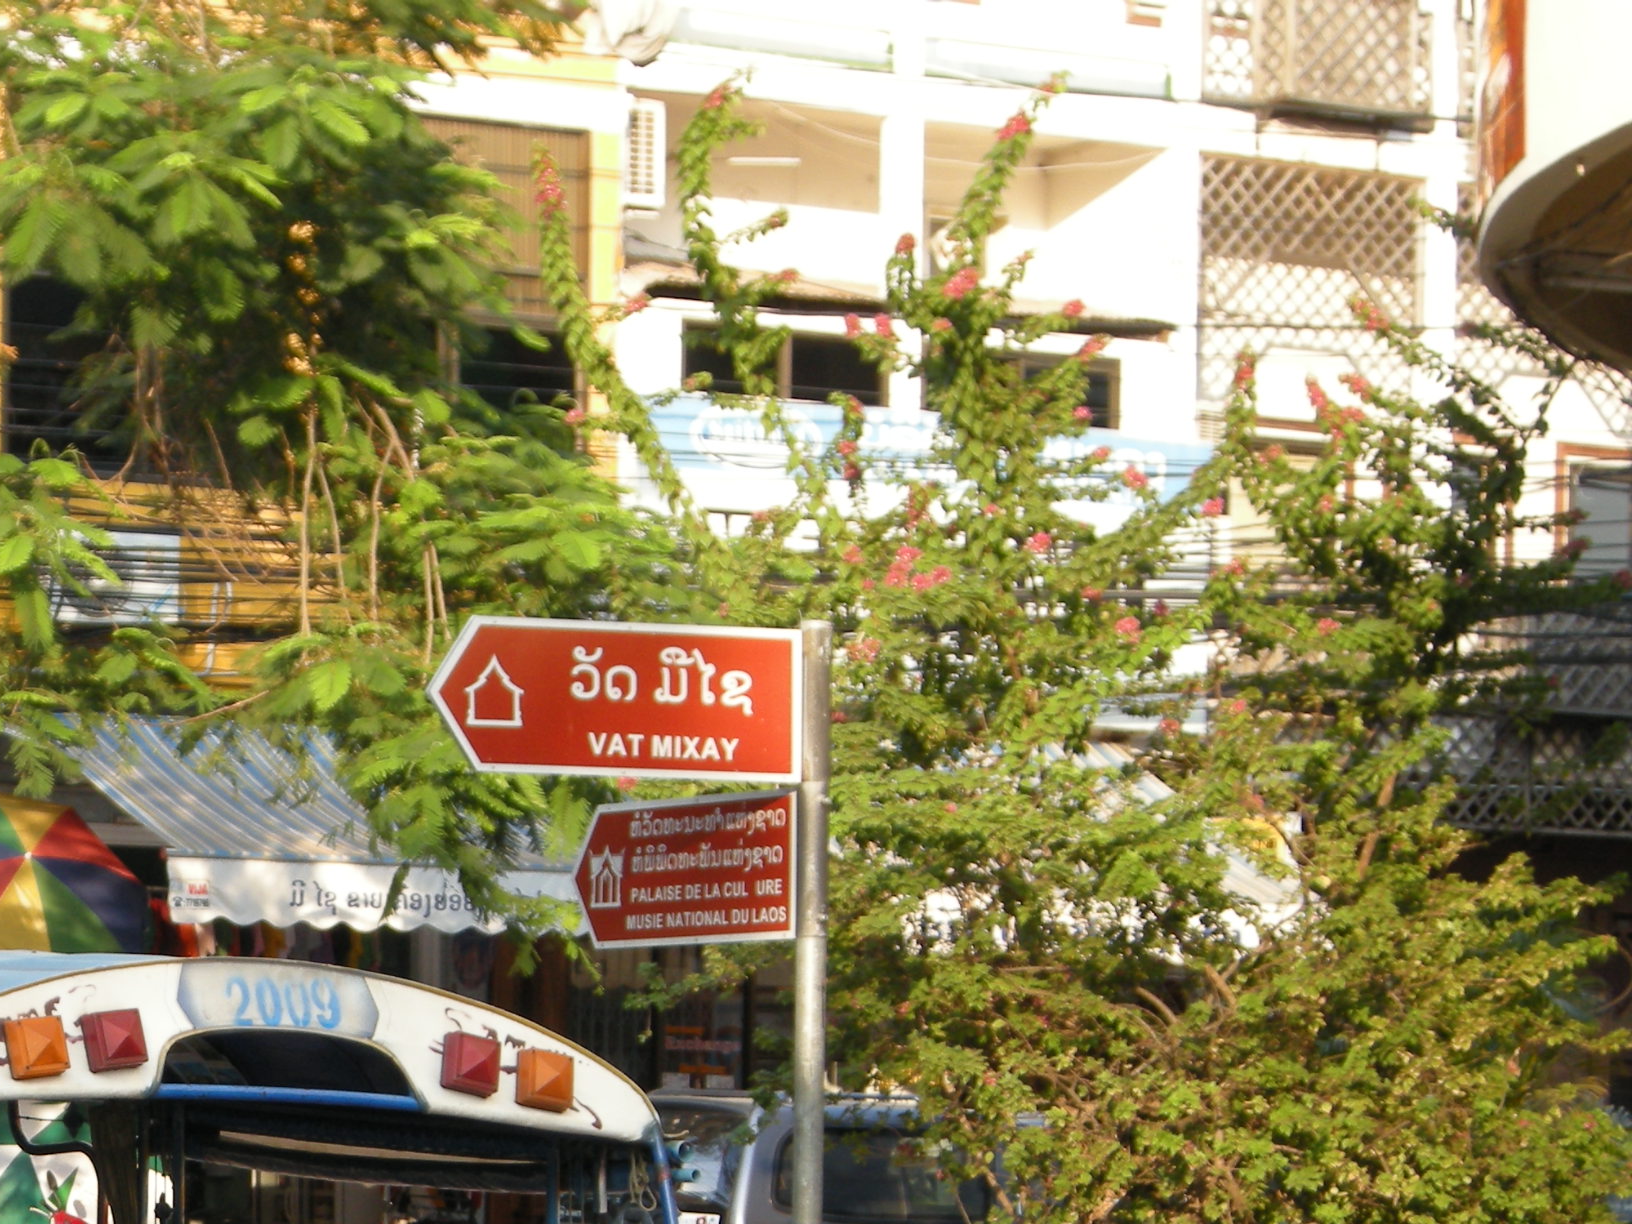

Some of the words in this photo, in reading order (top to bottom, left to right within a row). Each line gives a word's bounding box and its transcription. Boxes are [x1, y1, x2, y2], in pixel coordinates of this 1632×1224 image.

[570, 645, 638, 701] ວັດ
[588, 731, 644, 758] VAT
[651, 734, 739, 761] MIXAY
[630, 885, 682, 903] PALAISE
[685, 884, 701, 899] DE
[705, 883, 721, 898] LA
[666, 910, 729, 928] NATIONAL
[731, 909, 748, 924] DU
[751, 906, 787, 923] LAOS
[225, 976, 342, 1029] 2009
